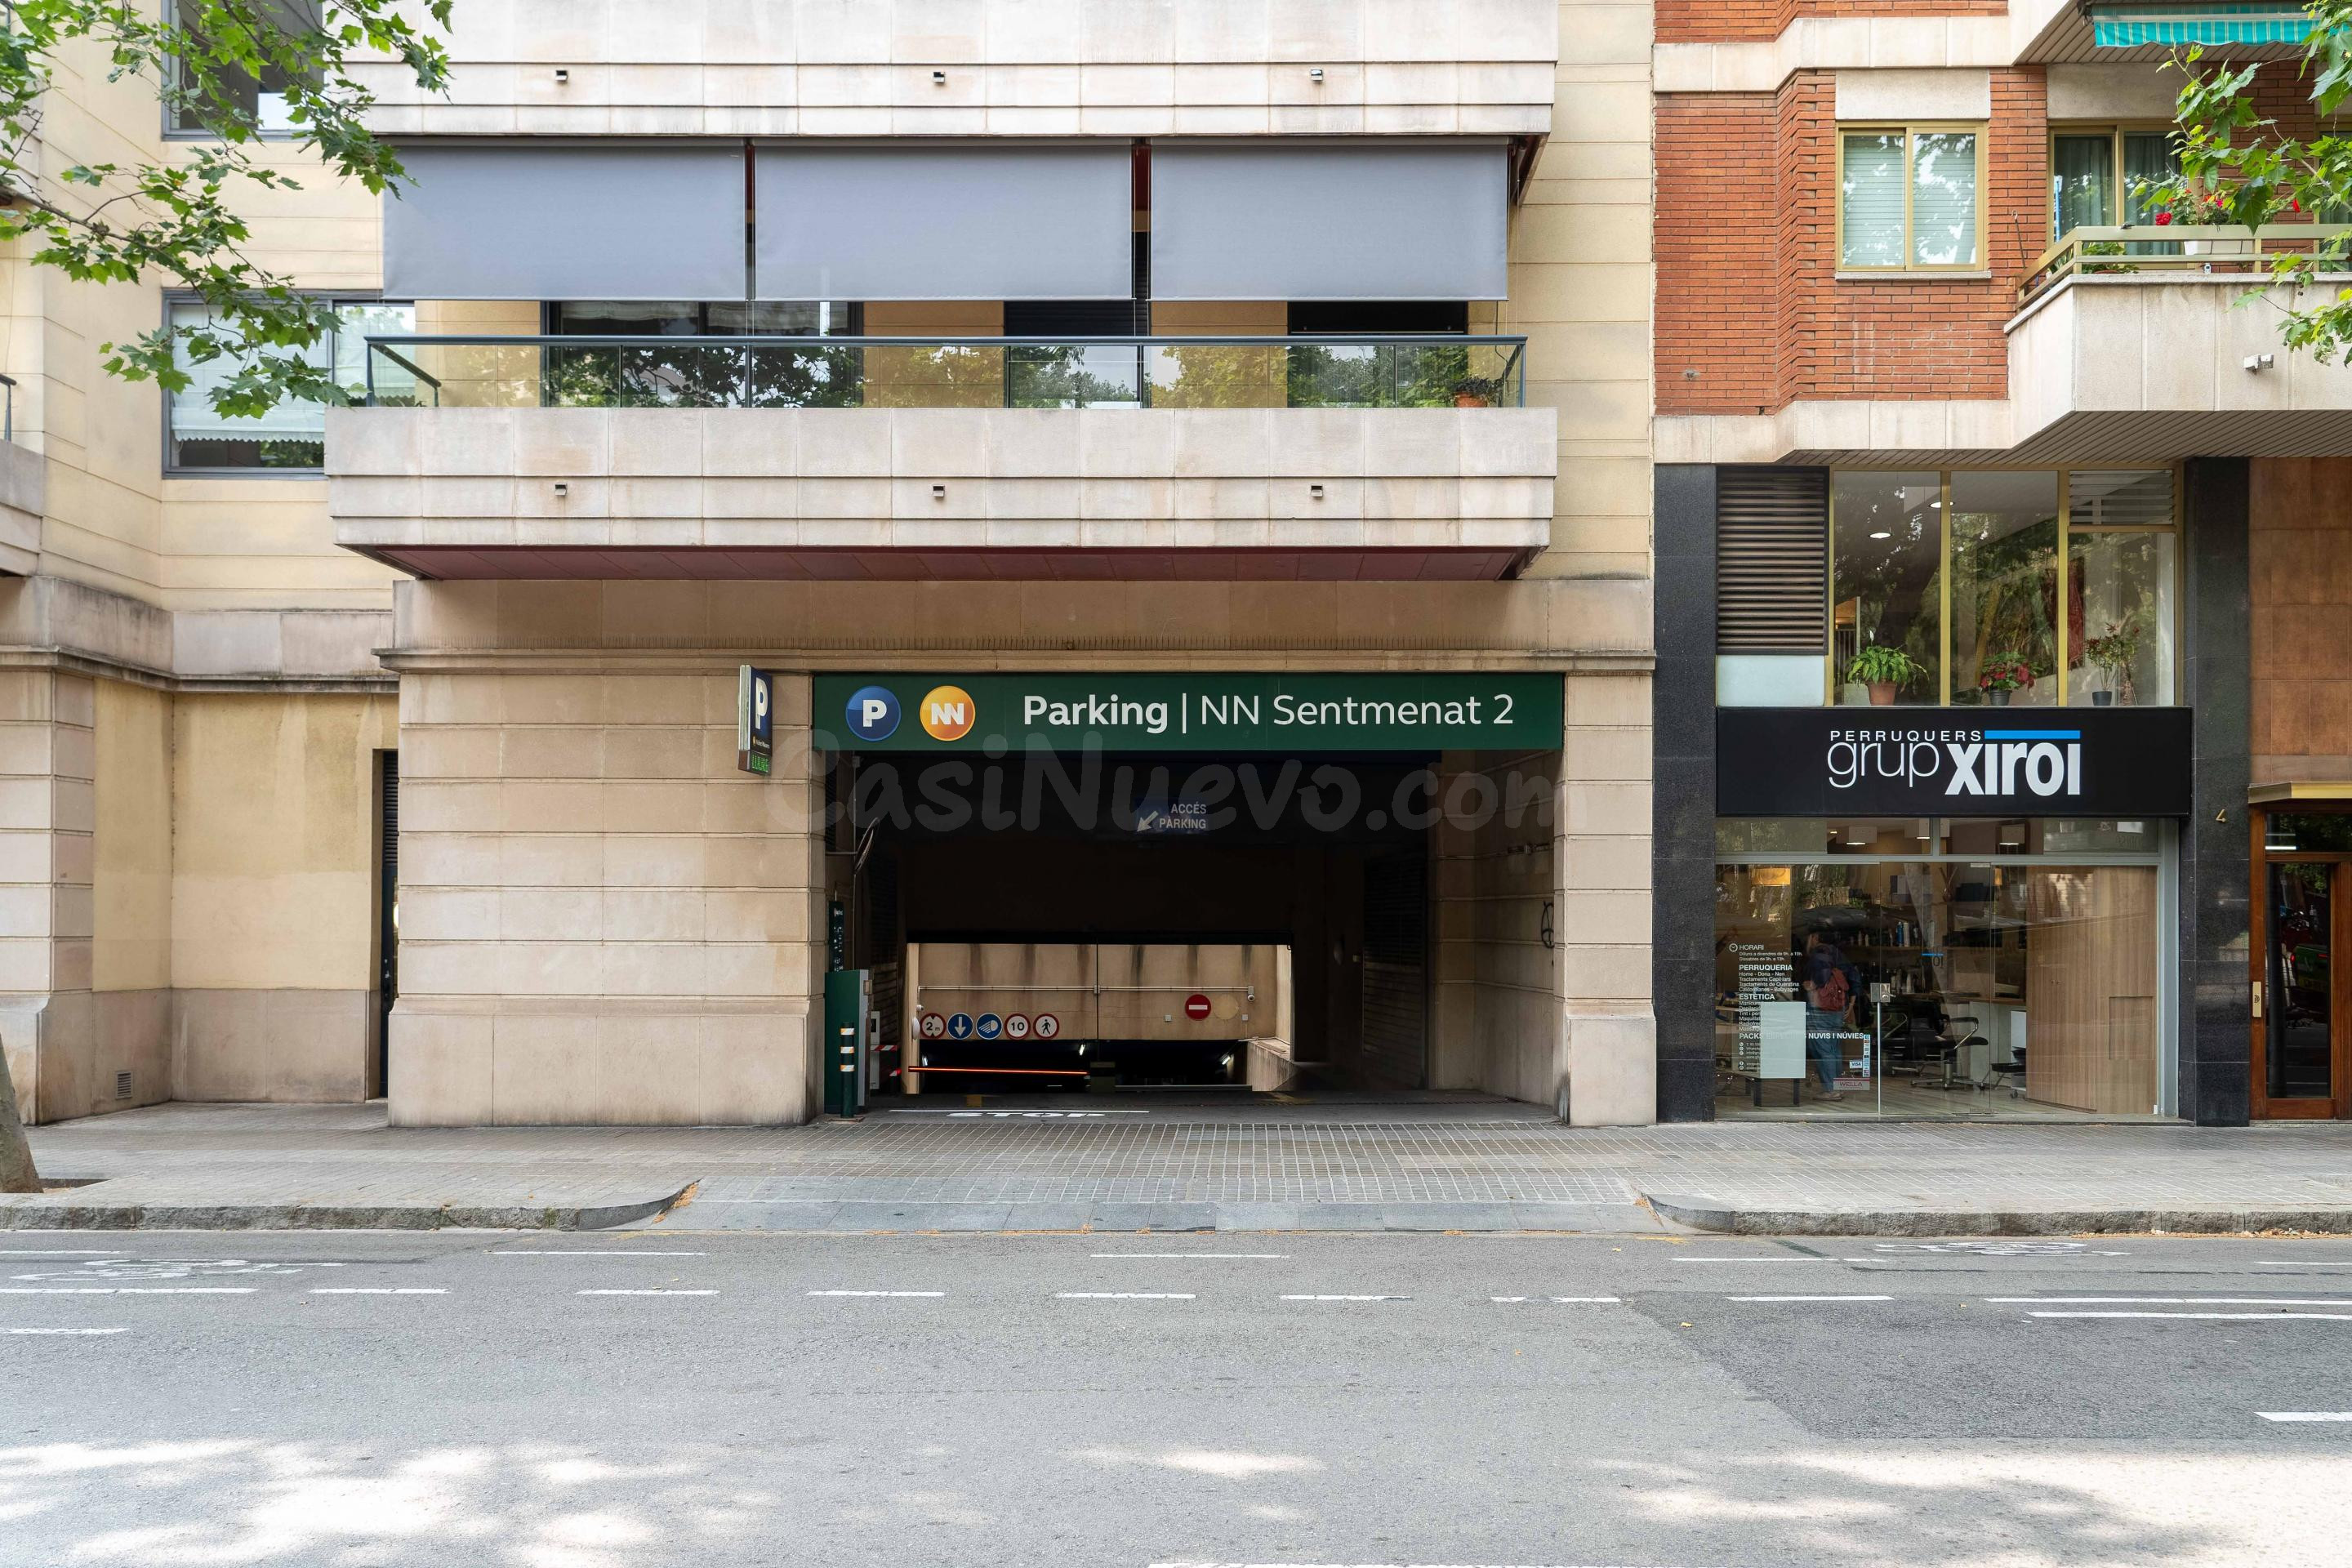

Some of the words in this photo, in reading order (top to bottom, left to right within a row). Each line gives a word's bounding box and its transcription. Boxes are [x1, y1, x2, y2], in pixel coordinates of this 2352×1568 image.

[755, 677, 768, 730] P
[862, 699, 888, 728] P
[1024, 694, 1168, 733] Parking
[1201, 695, 1259, 725] NN
[1272, 694, 1481, 725] Sentmenat
[1493, 694, 1513, 724] 2
[1830, 730, 1981, 741] PERRUQUERS
[1827, 739, 1940, 788] grup
[1171, 801, 1206, 814] ACCÉS
[1159, 817, 1206, 830] PARKING
[925, 1022, 933, 1031] 2
[1010, 1022, 1025, 1031] 10
[1836, 1031, 1864, 1040] NÚVIES
